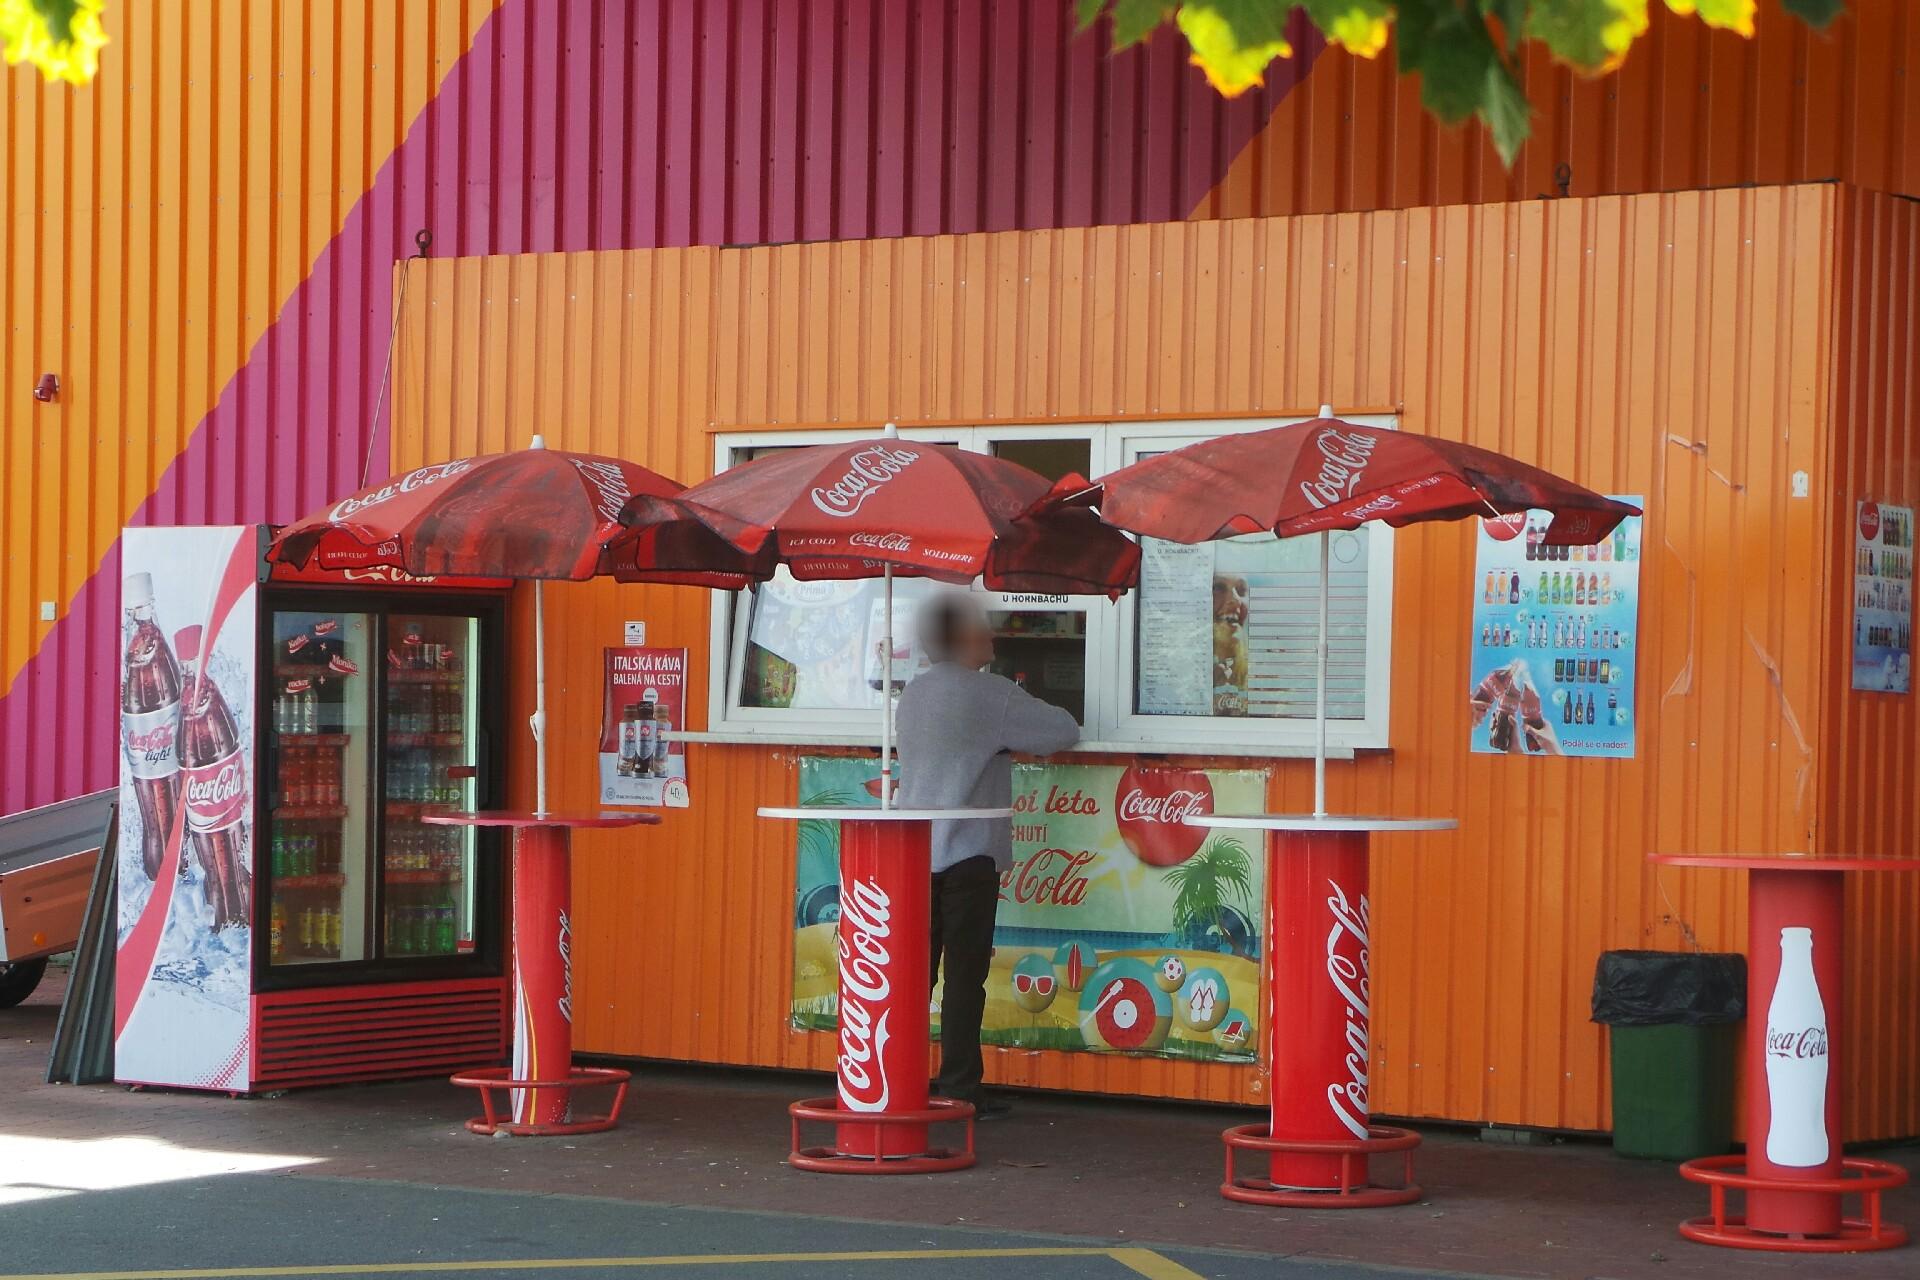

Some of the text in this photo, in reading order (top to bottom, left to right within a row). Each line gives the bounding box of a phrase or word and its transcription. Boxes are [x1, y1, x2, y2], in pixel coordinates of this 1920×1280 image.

[329, 458, 470, 522] Coca-Cola
[811, 445, 919, 517] Coca-Cola
[808, 538, 836, 546] COLD
[849, 532, 913, 552] Coca-Cola
[922, 548, 950, 560] SOLD
[949, 553, 976, 564] HERE
[1002, 595, 1069, 604] U HORNBACHU
[614, 654, 681, 671] ITALSKÁ KÁVA
[613, 672, 681, 686] BALENÁ NA CESTY
[1044, 785, 1101, 815] léto
[1120, 788, 1208, 823] Coca-Cola
[996, 848, 1098, 906] a-Cola
[838, 868, 891, 1112] Coca-Cola
[1768, 1027, 1827, 1059] Coca-Cola
